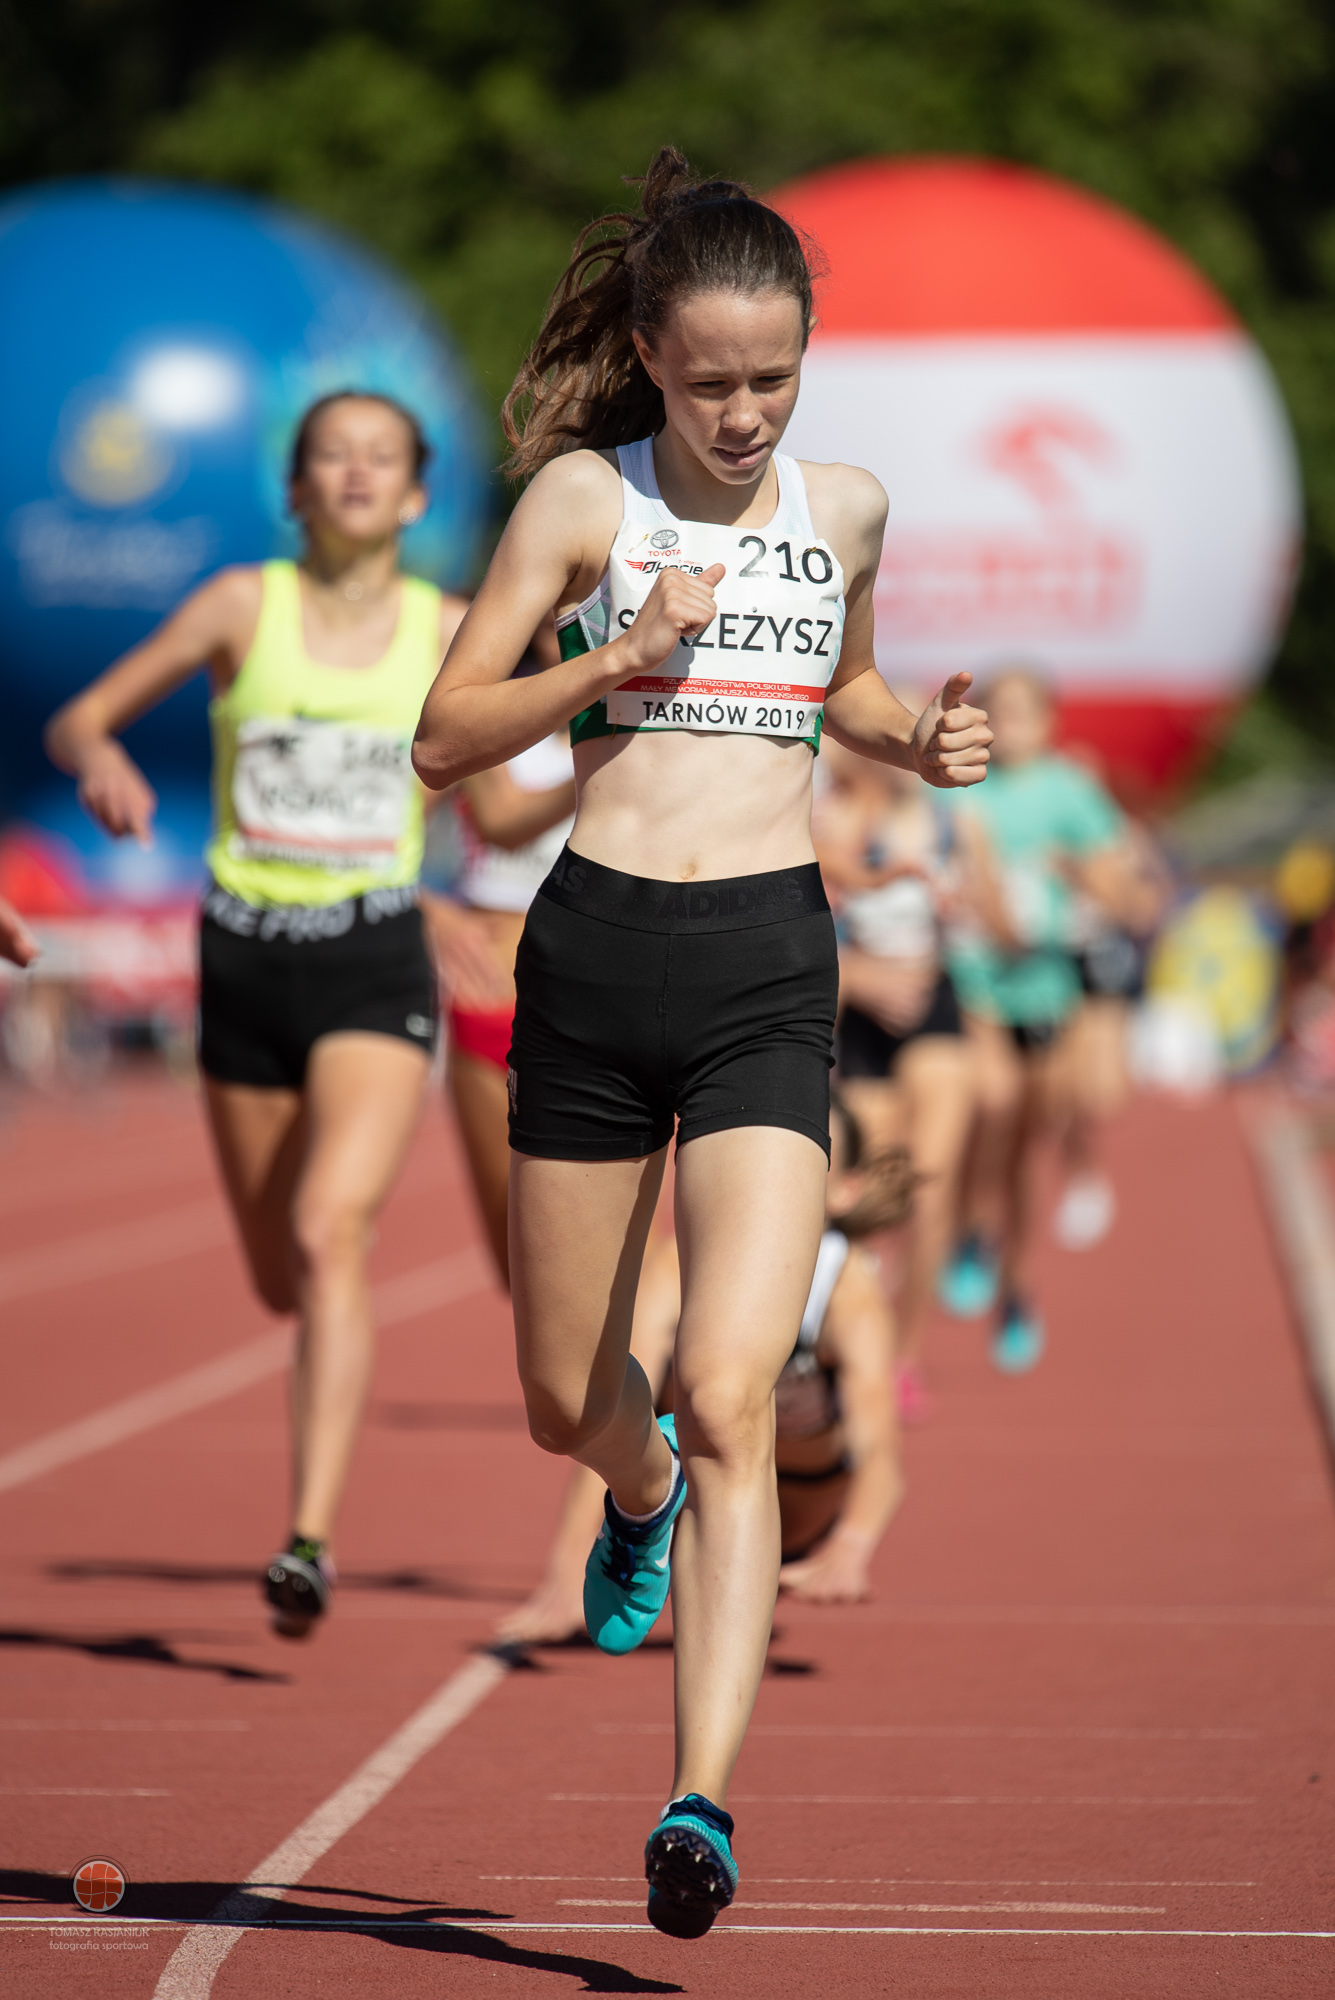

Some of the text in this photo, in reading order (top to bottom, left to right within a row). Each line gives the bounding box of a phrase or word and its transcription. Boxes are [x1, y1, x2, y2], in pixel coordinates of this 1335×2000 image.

[648, 549, 682, 557] TOYOTA
[738, 535, 834, 585] 210
[617, 606, 833, 656] SZEŻYSZ
[665, 686, 709, 694] MEMORIAŁ
[710, 688, 749, 697] JANUSZA
[749, 690, 810, 701] KUSOCIŃSKIEGO
[686, 679, 746, 689] MISTRZOSTWA
[746, 682, 777, 692] POLSKI
[643, 698, 805, 730] TARNÓW 2019
[656, 879, 804, 919] ADIDAS
